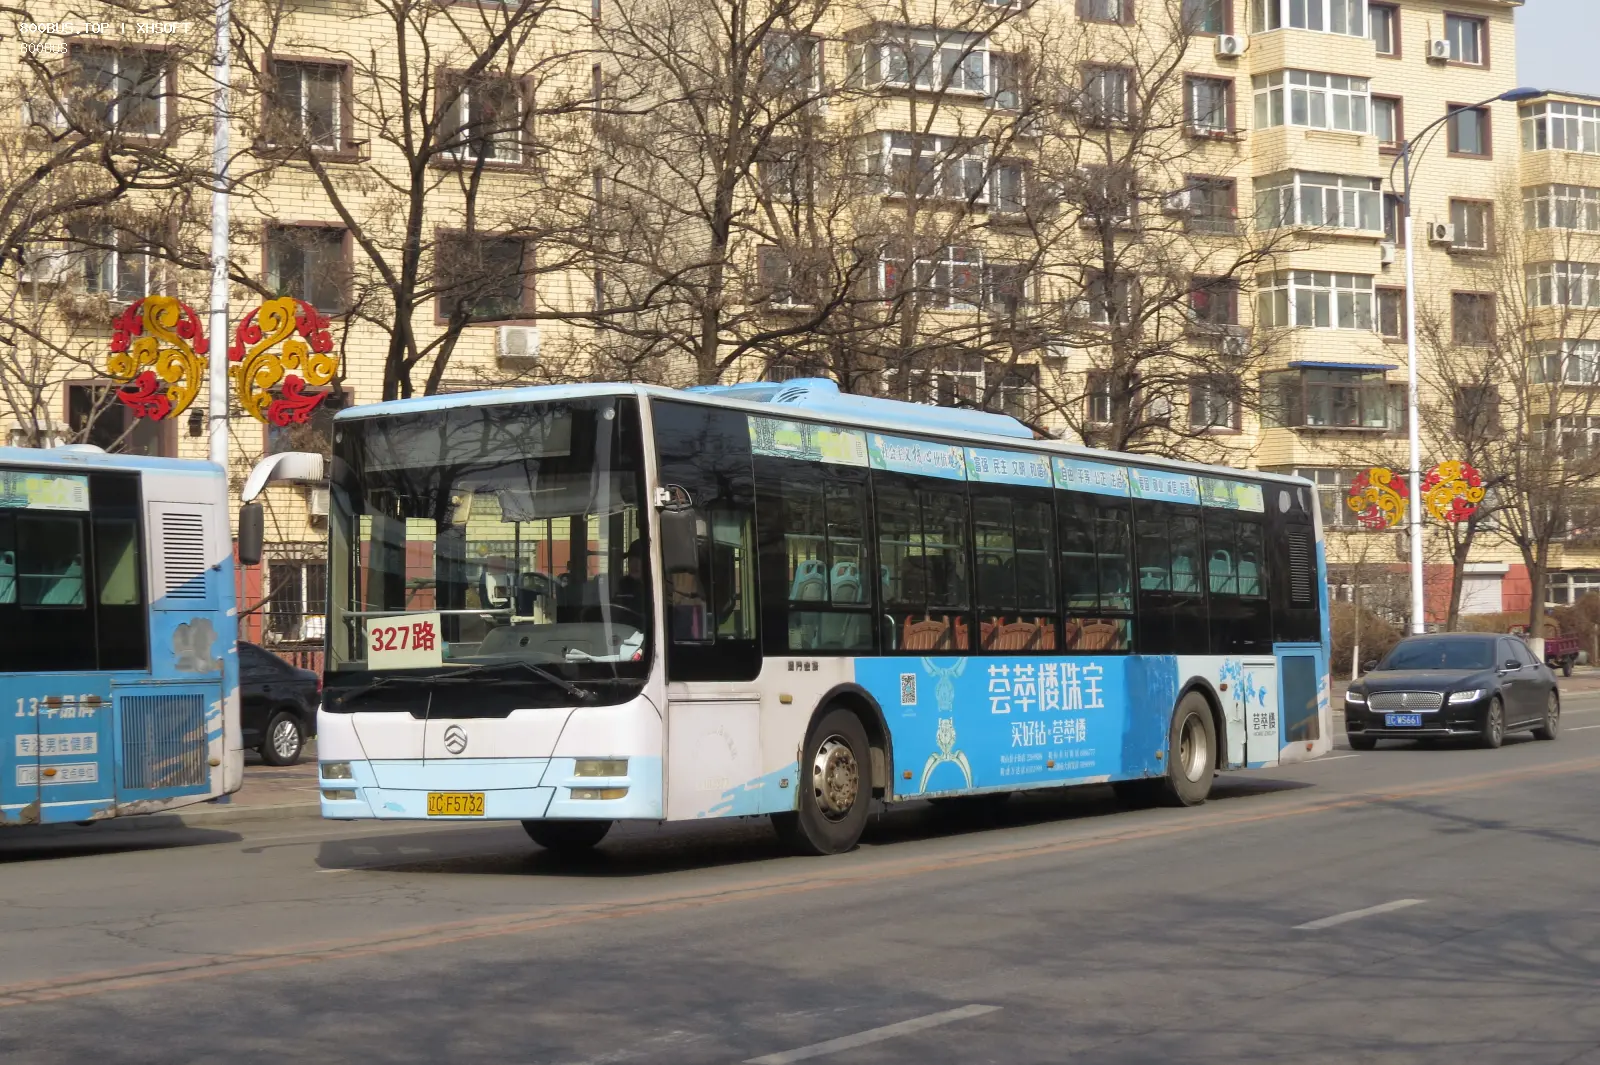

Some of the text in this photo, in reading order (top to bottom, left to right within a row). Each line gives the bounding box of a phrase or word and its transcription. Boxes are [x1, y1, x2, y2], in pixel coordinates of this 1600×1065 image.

[370, 620, 436, 652] 327路
[988, 662, 1105, 715] 荟萃楼珠宝
[19, 735, 94, 753] 专注男性健康
